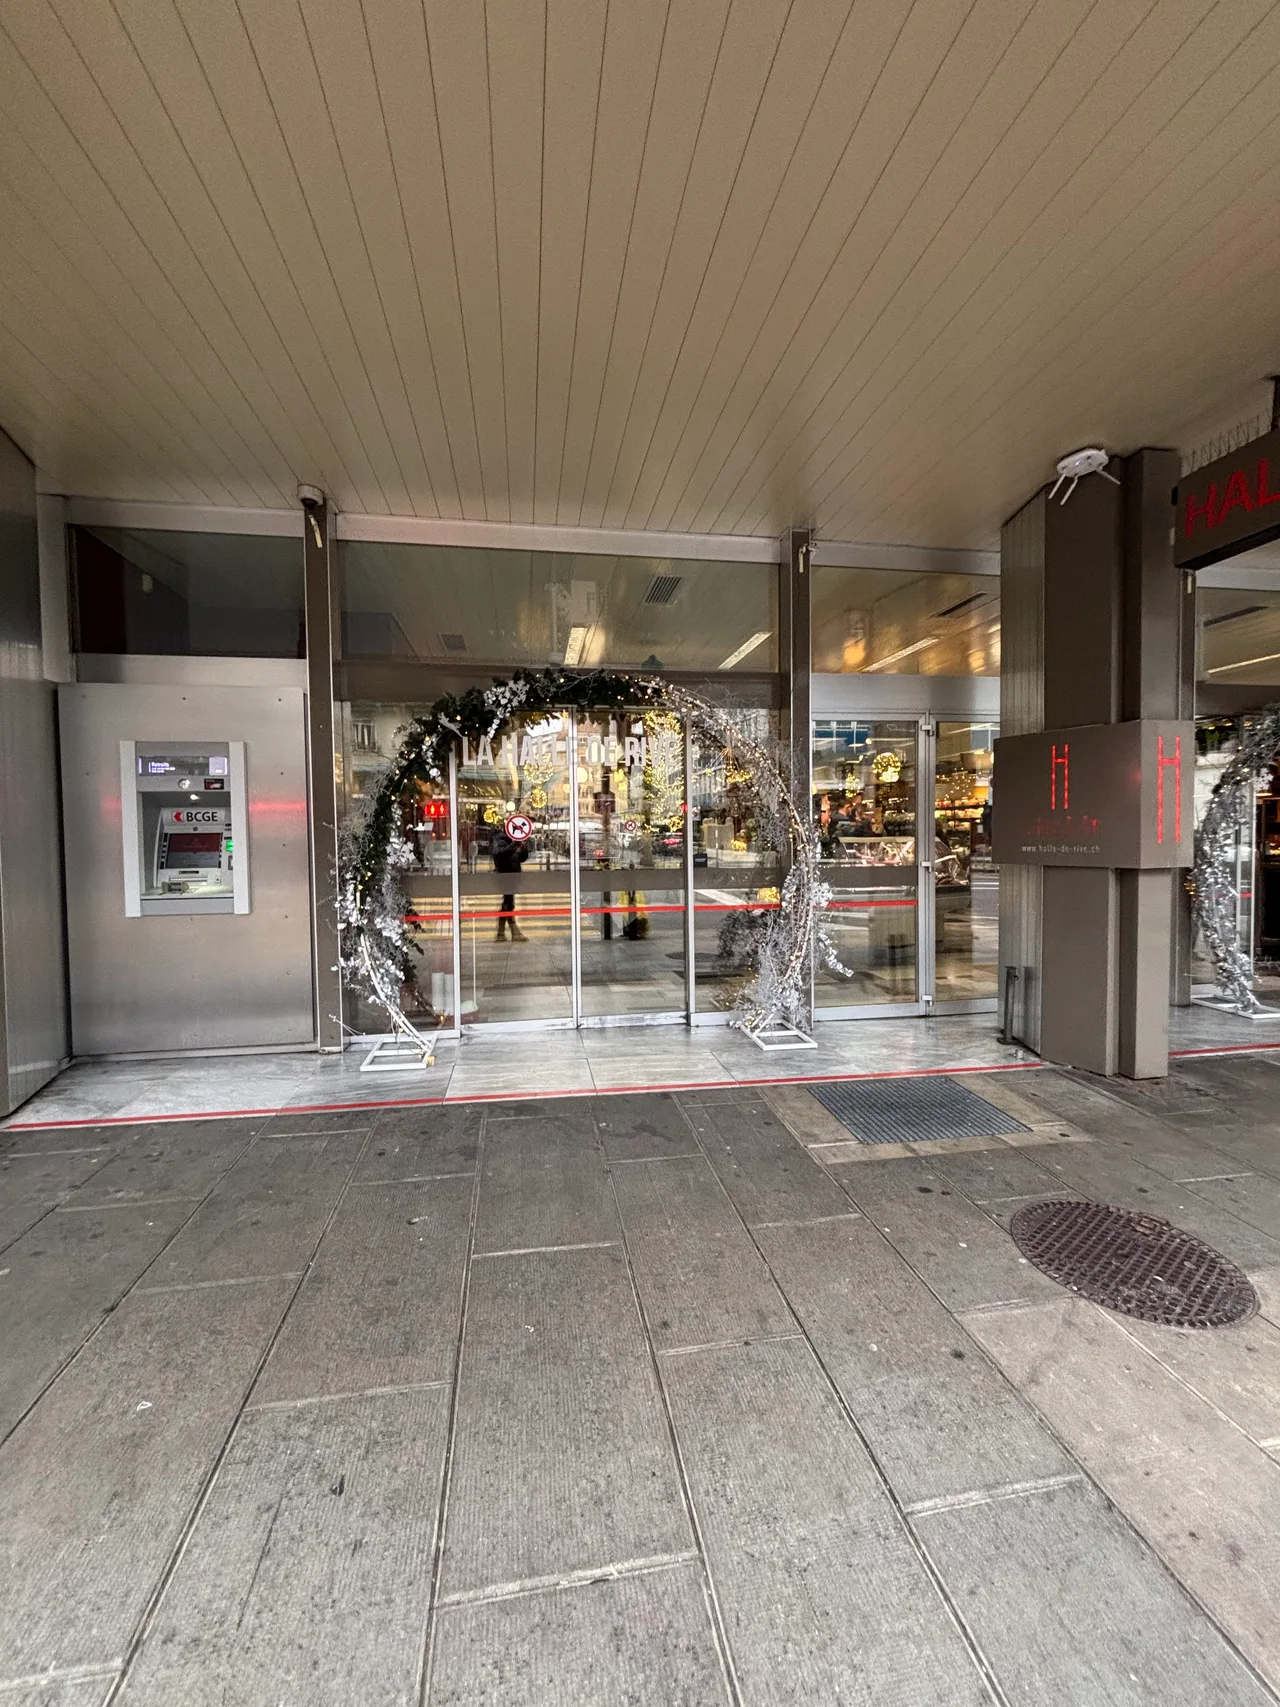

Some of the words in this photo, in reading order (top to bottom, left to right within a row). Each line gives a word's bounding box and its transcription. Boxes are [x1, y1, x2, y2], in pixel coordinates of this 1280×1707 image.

[462, 735, 494, 766] LA
[625, 737, 679, 767] RIVE
[1051, 743, 1069, 810] H
[1156, 735, 1181, 844] H
[186, 811, 218, 822] BCGE
